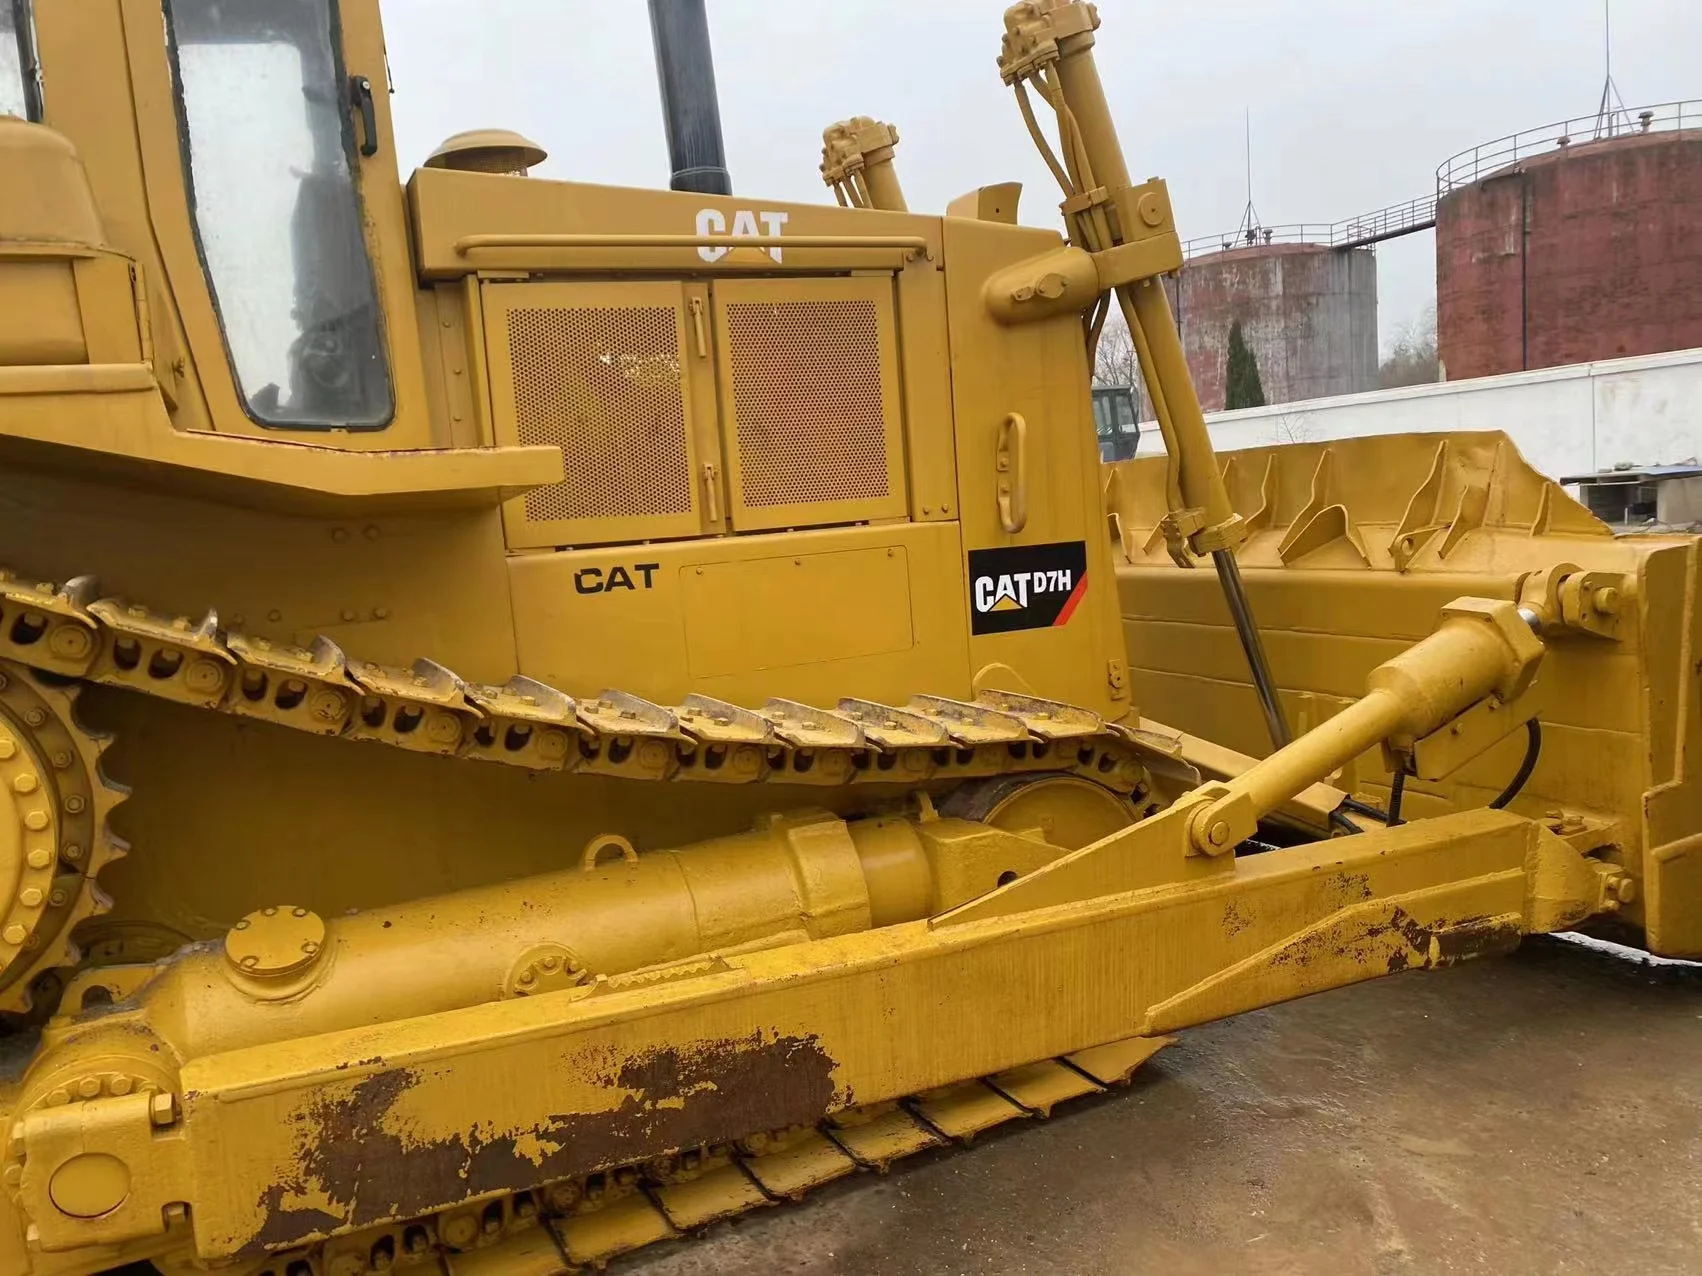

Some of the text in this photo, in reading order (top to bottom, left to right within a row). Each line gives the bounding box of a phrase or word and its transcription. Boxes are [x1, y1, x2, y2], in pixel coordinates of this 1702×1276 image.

[695, 208, 788, 264] CAT
[574, 563, 660, 594] CAT
[975, 569, 1072, 613] CAT D7H
